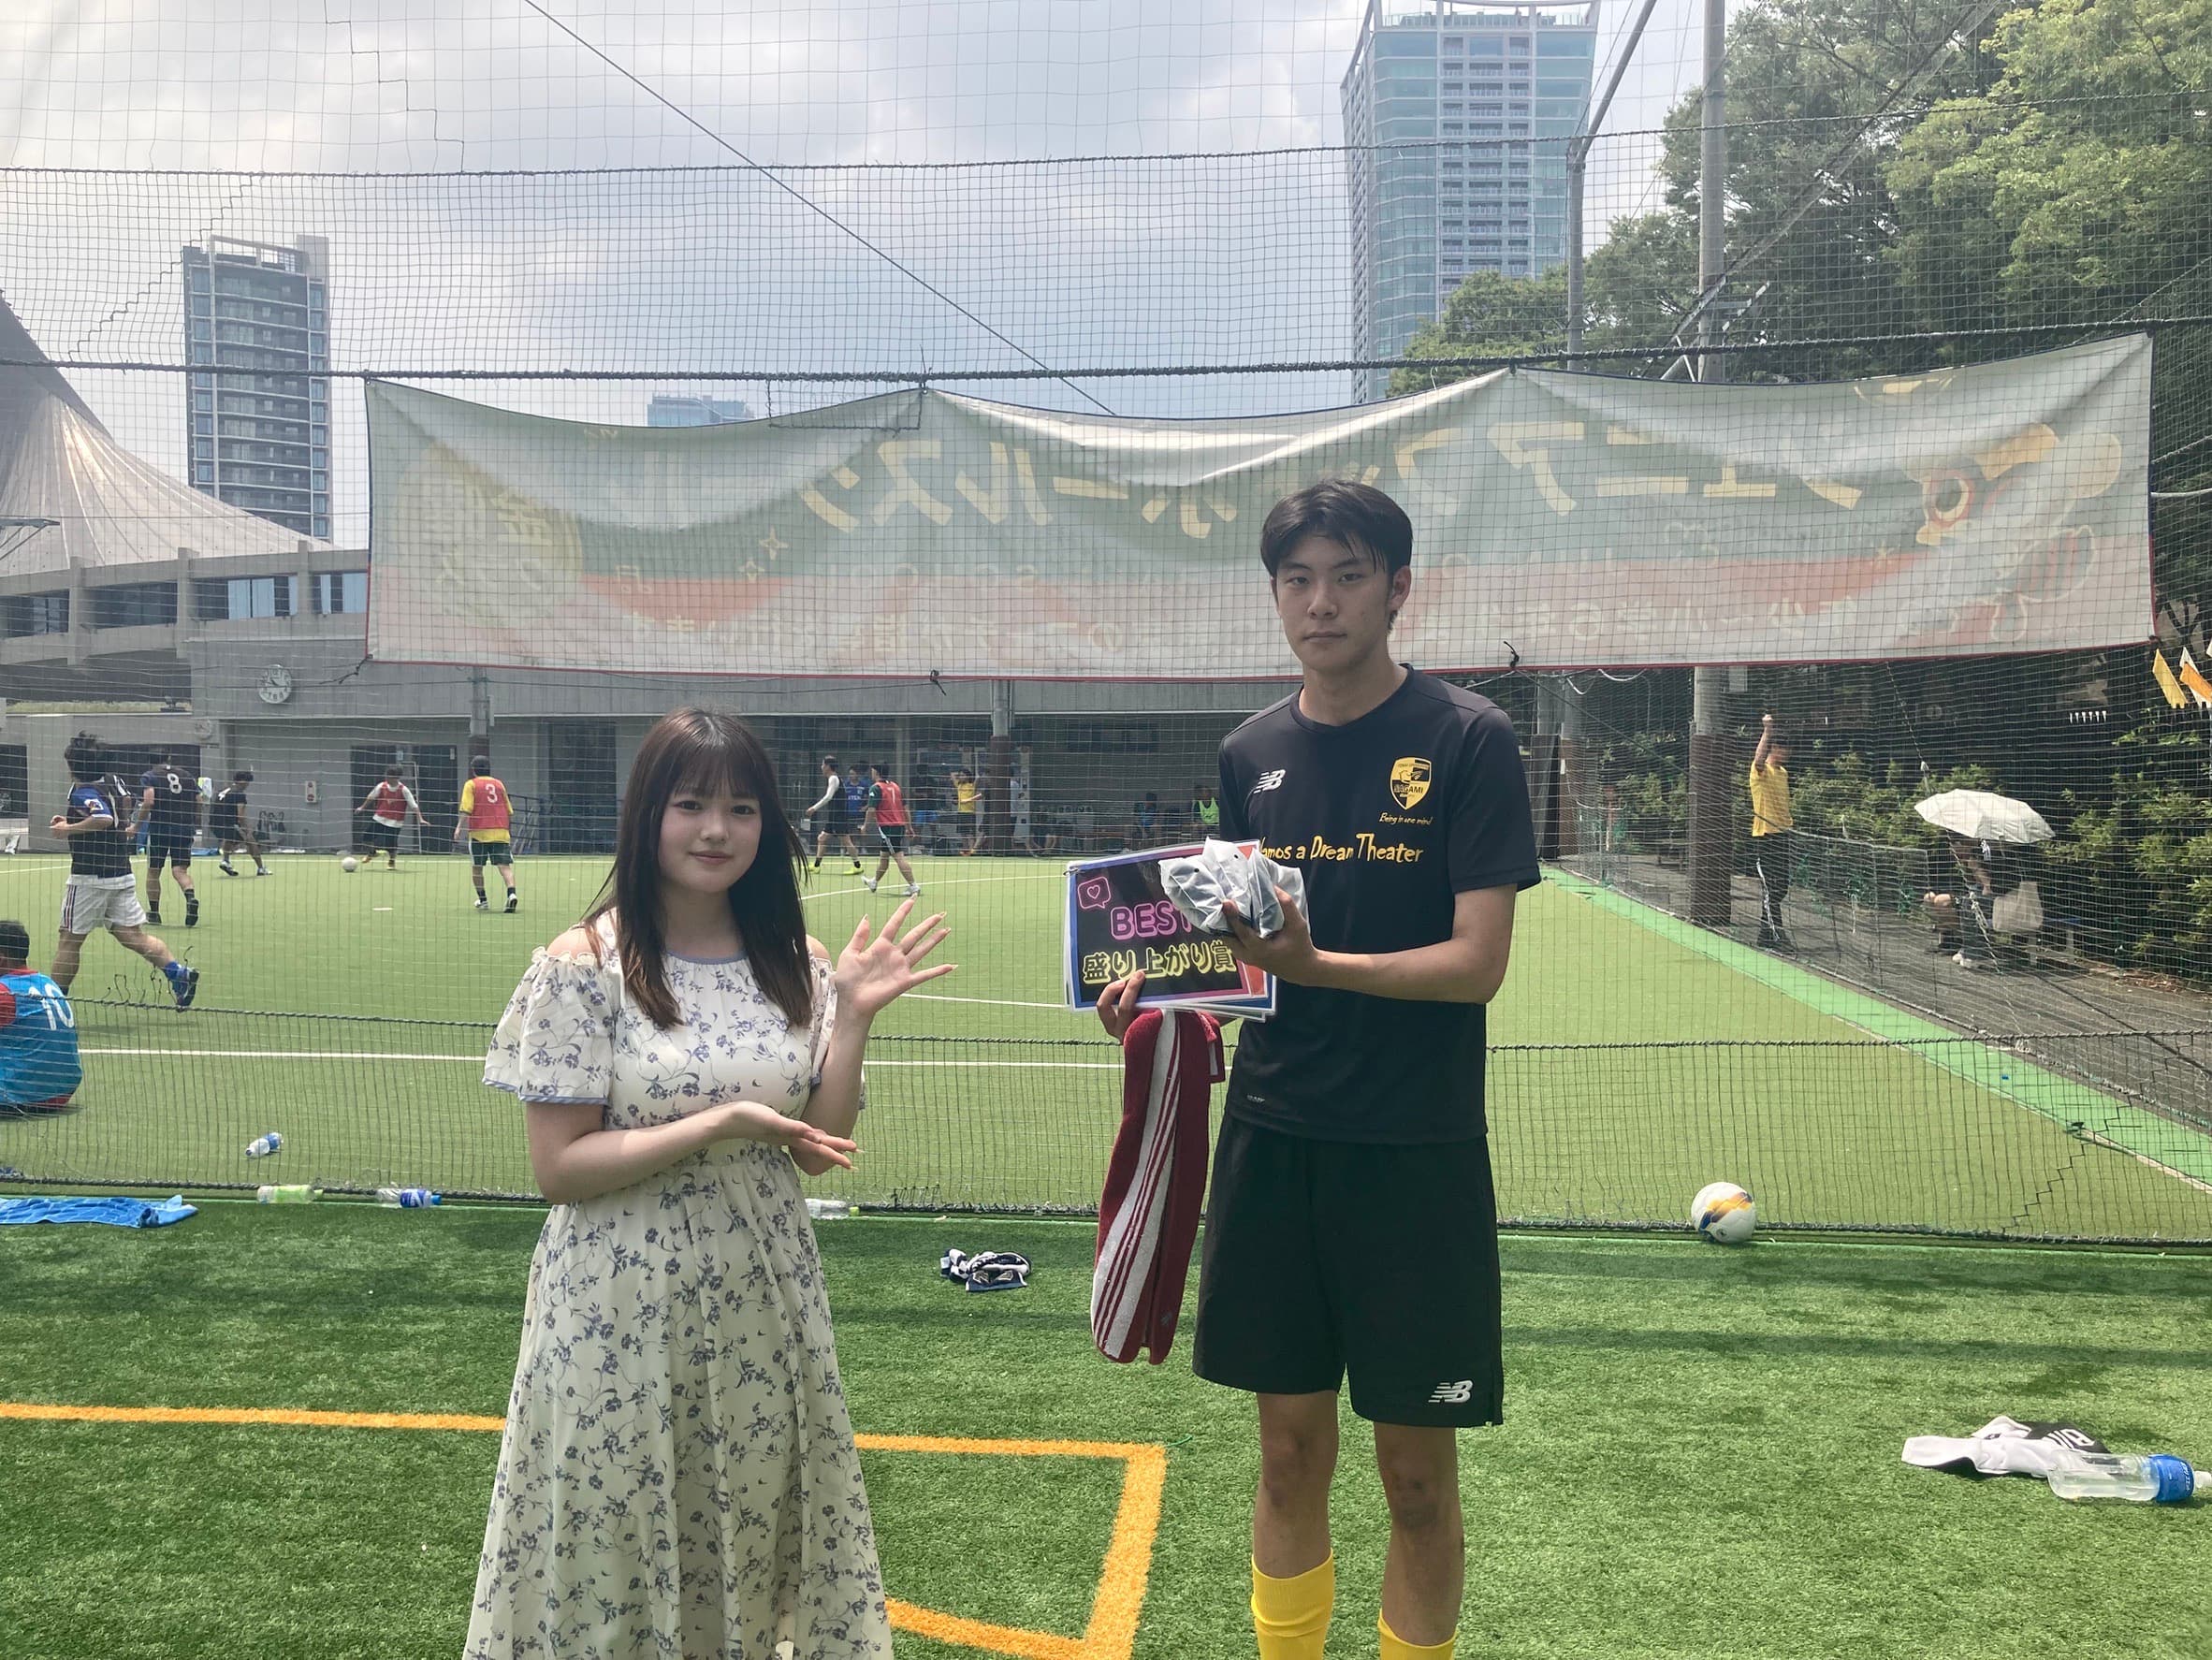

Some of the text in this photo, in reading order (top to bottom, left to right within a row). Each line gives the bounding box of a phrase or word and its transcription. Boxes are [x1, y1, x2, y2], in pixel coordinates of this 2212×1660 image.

[167, 773, 182, 794] 8
[485, 783, 498, 804] 3
[1295, 845, 1306, 860] a
[1356, 833, 1423, 863] Theater
[1083, 939, 1237, 985] 盛り上がり賞
[29, 983, 75, 1030] 10
